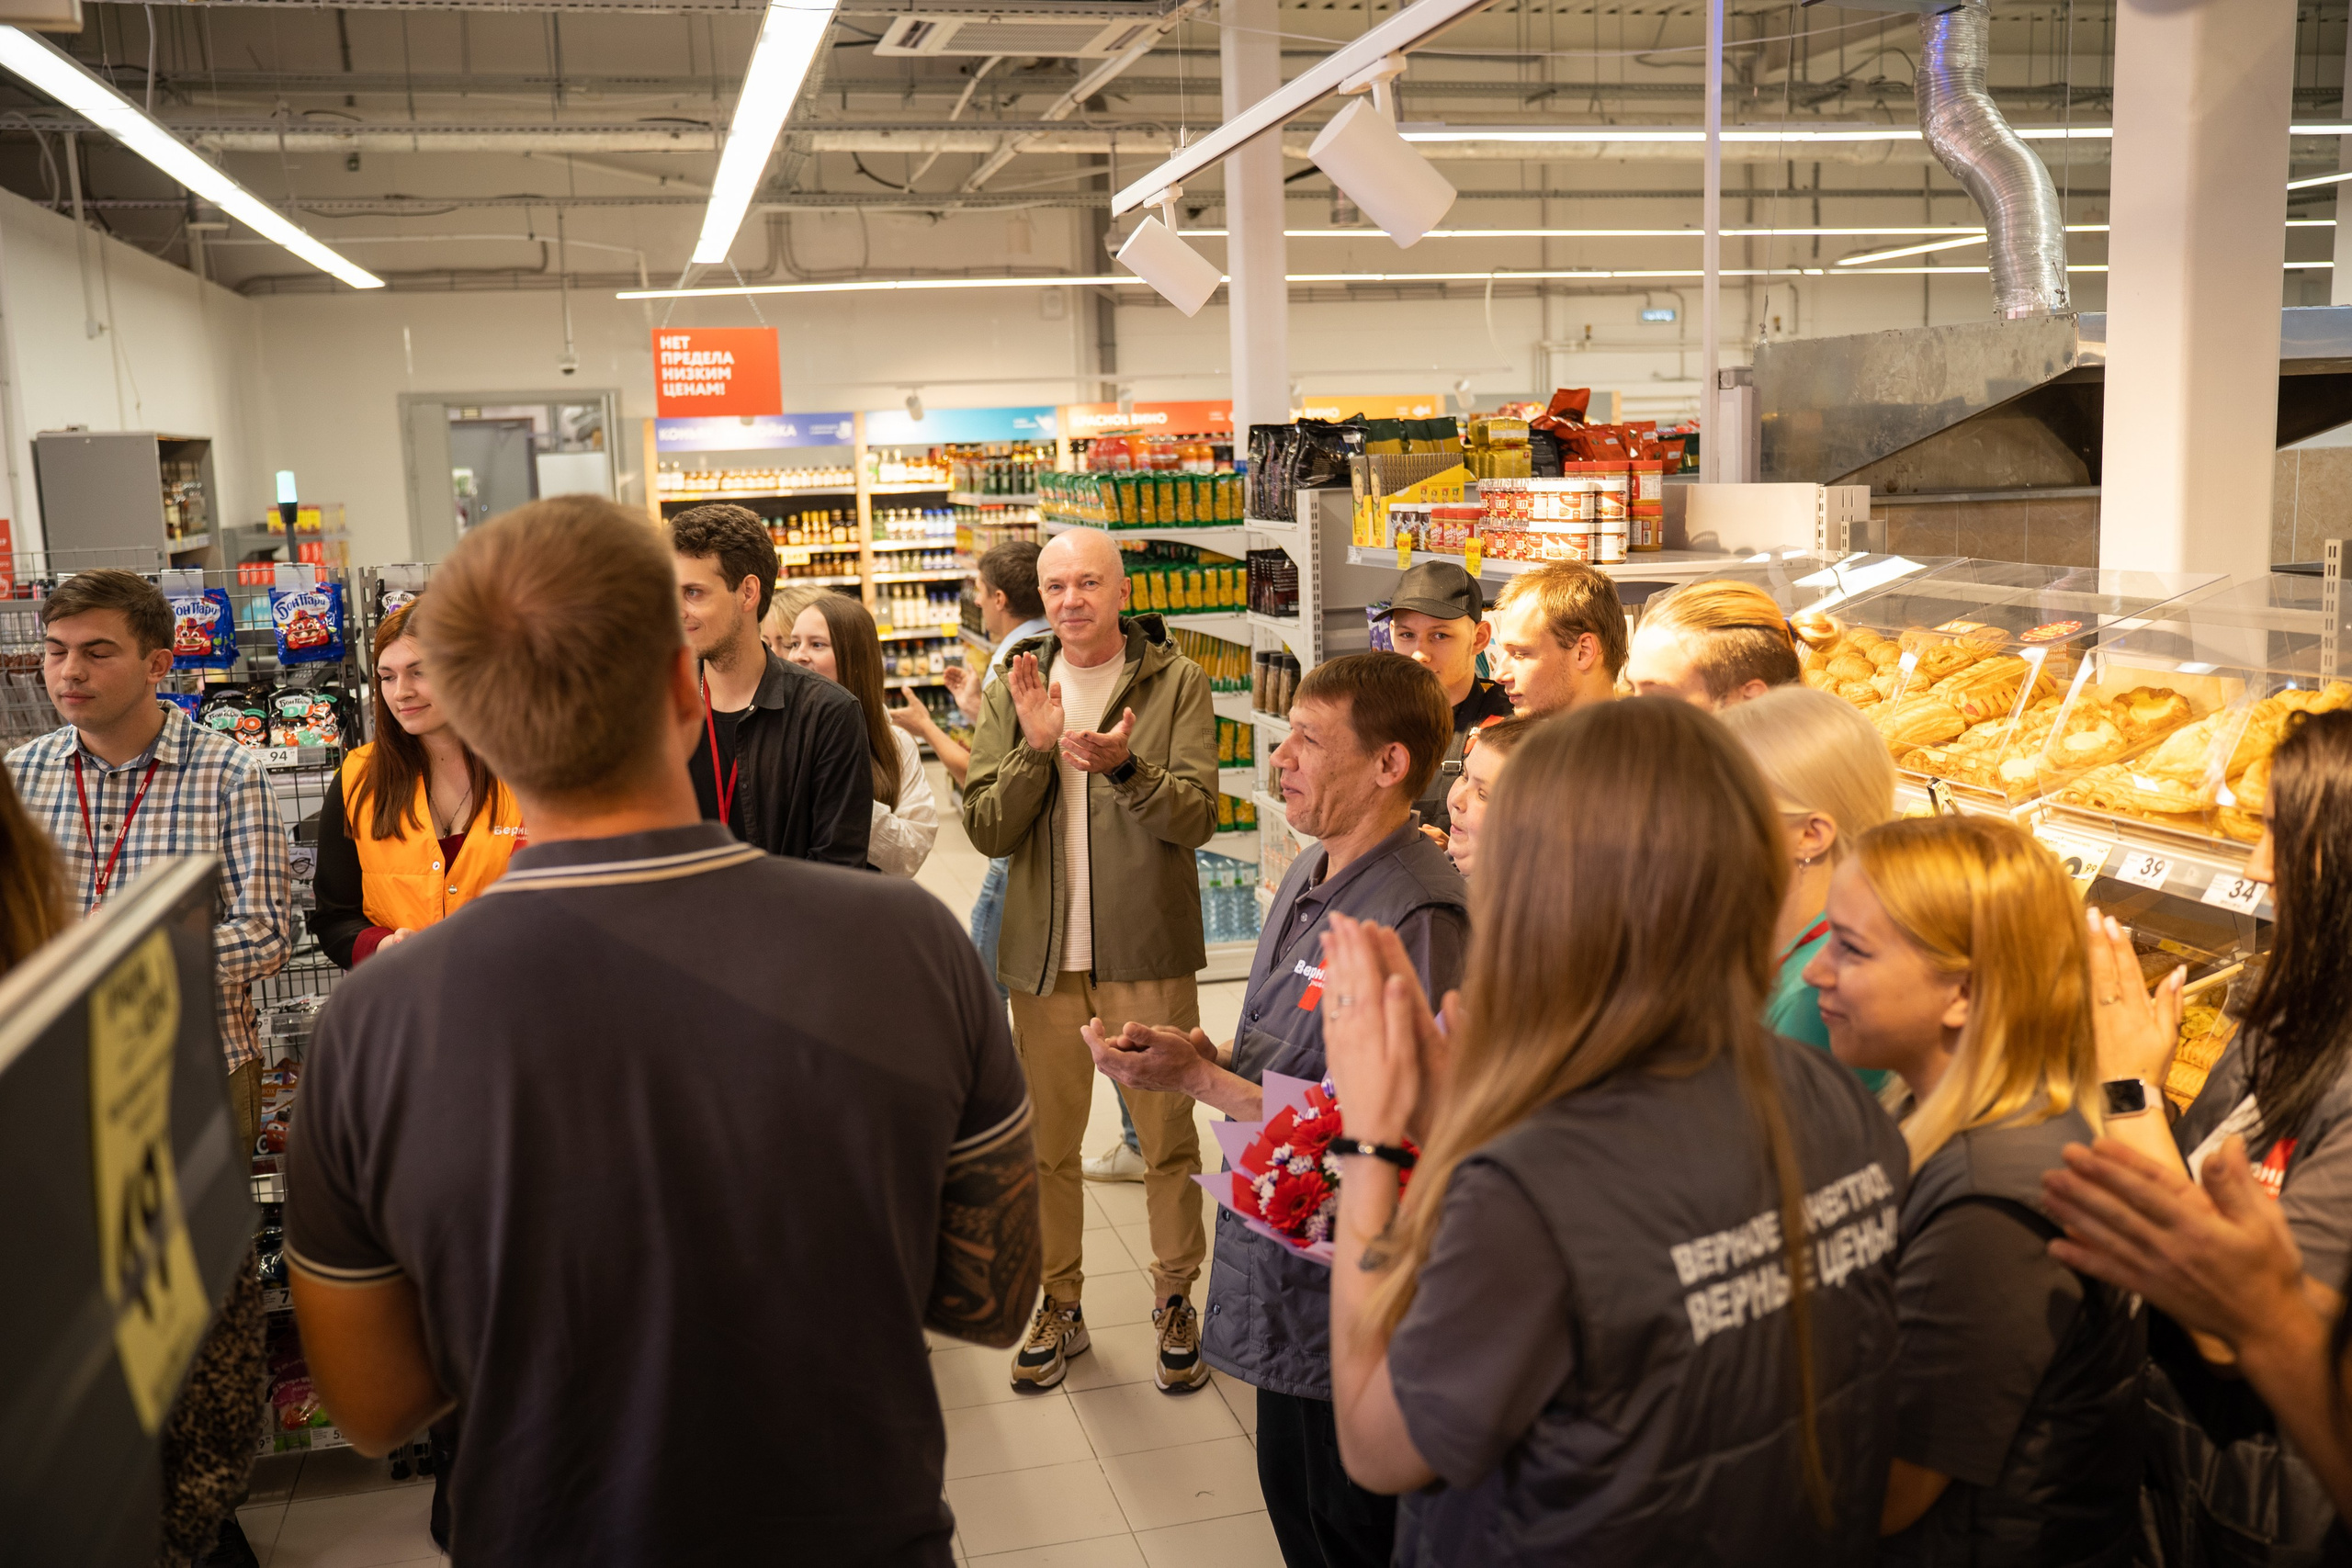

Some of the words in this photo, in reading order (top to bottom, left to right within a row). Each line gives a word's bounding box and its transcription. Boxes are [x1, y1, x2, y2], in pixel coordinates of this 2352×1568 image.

[660, 335, 691, 350] НЕТ
[661, 350, 735, 367] ПРЕДЕЛА
[662, 367, 732, 380] НИЗКИМ
[662, 382, 726, 398] ЦЕНАМ!
[277, 597, 299, 620] Бон
[298, 592, 326, 609] Пари
[283, 704, 331, 717] DUO
[212, 716, 262, 731] DUO
[269, 750, 288, 761] 94
[2086, 863, 2098, 874] 99
[2140, 857, 2165, 878] 39
[2228, 879, 2257, 903] 34
[1670, 1209, 1782, 1287] ВЕРНОЕ
